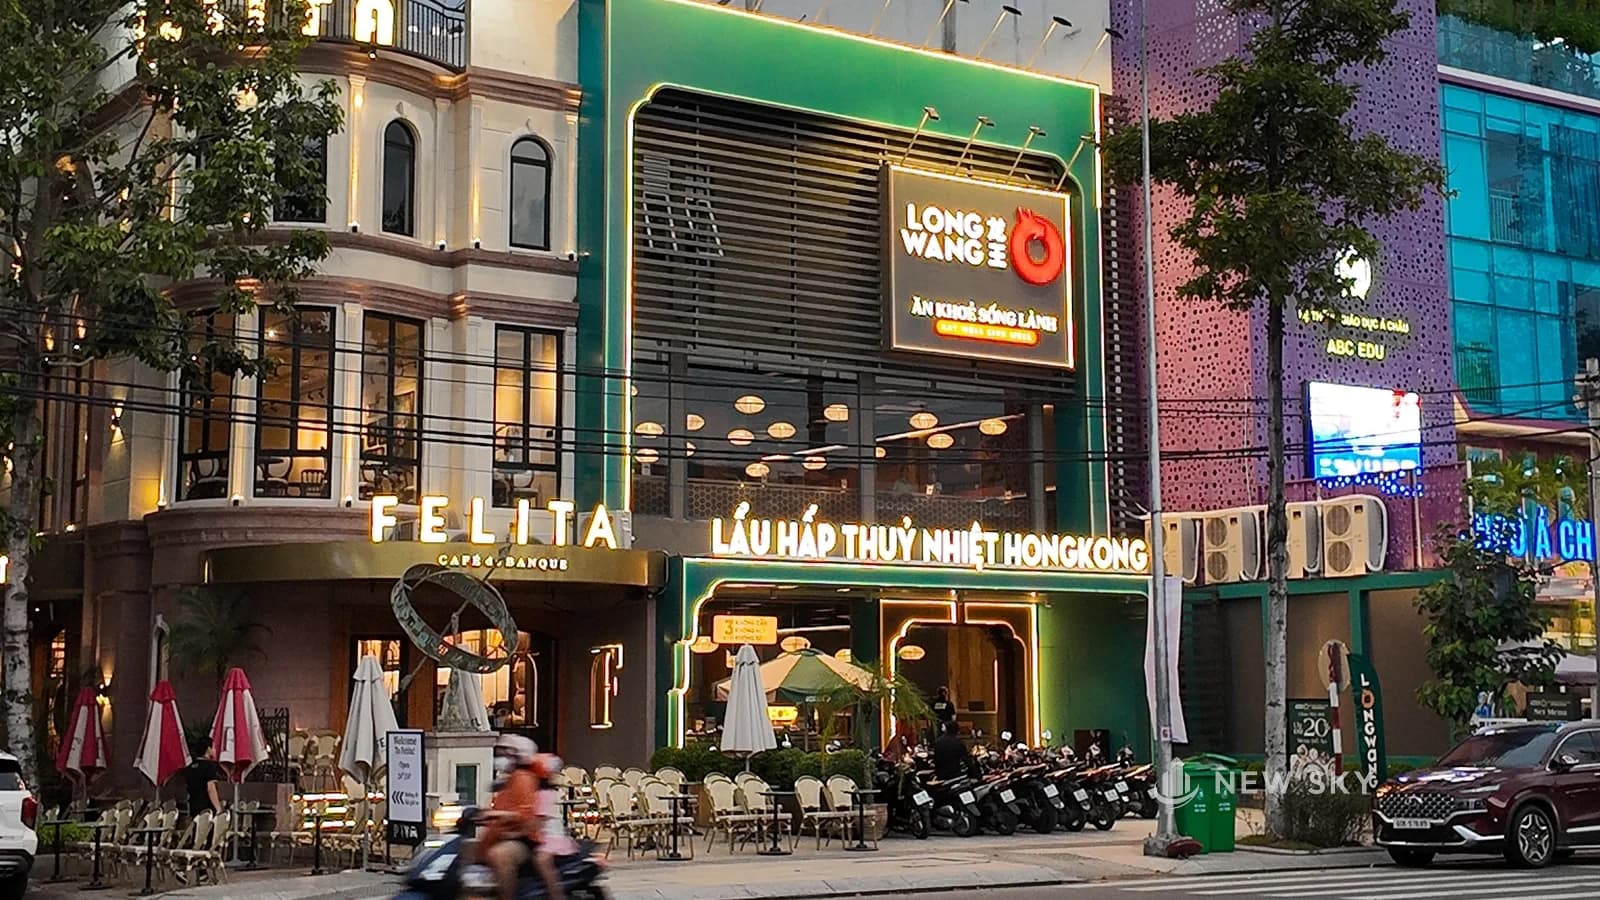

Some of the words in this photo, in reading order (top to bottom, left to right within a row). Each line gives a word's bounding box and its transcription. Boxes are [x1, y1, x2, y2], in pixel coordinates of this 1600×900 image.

[906, 203, 985, 240] LONG
[900, 229, 985, 266] WANG
[1326, 338, 1356, 357] ABC
[1357, 341, 1385, 360] EDU
[370, 495, 618, 550] FELITA
[776, 503, 837, 559] HẤP
[921, 520, 999, 573] NHIỆT
[1003, 531, 1149, 572] HONGKONG
[438, 553, 481, 568] CAFÉ
[505, 557, 569, 571] BANQUE
